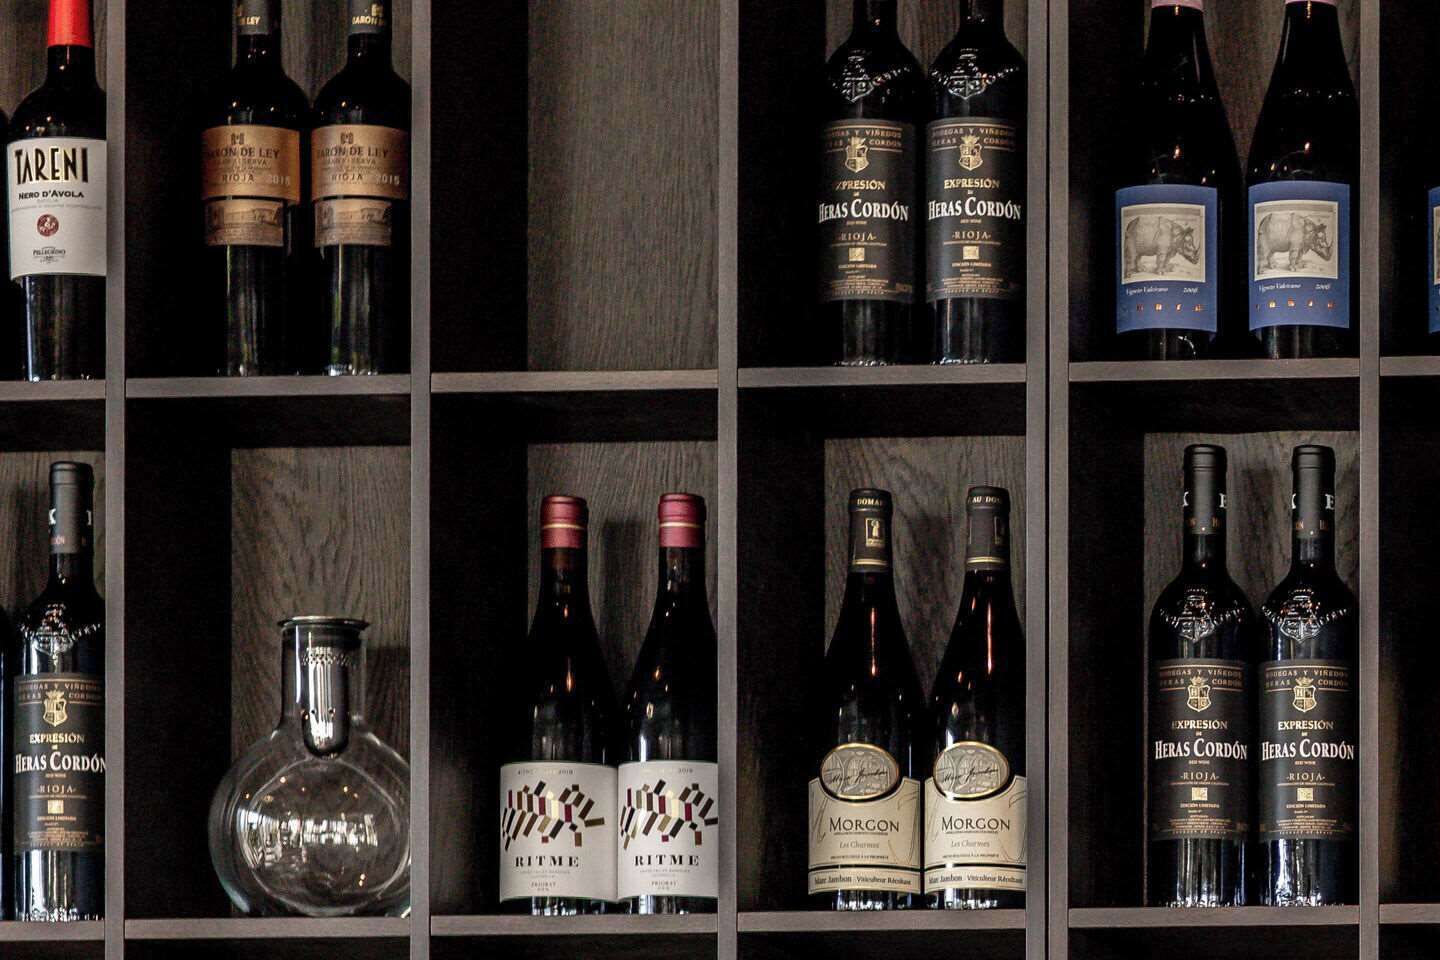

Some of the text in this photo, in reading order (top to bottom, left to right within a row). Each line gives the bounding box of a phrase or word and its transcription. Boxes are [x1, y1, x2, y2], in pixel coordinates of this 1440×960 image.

[260, 149, 280, 159] LEY
[14, 147, 89, 185] TARENI
[944, 178, 1000, 190] EXPRESIÓN
[18, 192, 40, 200] NERO
[818, 198, 910, 224] HERAS CORDÓN
[928, 197, 1021, 221] HERAS CORDÓN
[1172, 719, 1228, 730] EXPRESIÓN
[1278, 720, 1334, 730] EXPRESIÓN
[1155, 738, 1248, 761] HERAS CORDÓN
[1262, 738, 1354, 761] HERAS CORDÓN
[15, 751, 106, 774] HERAS CORDÓN
[1183, 772, 1217, 781] RIOJA
[1289, 772, 1323, 781] RIOJA
[829, 816, 899, 833] MORGON
[941, 815, 1010, 832] MORGON
[515, 855, 579, 867] RITME
[634, 854, 700, 866] RITME
